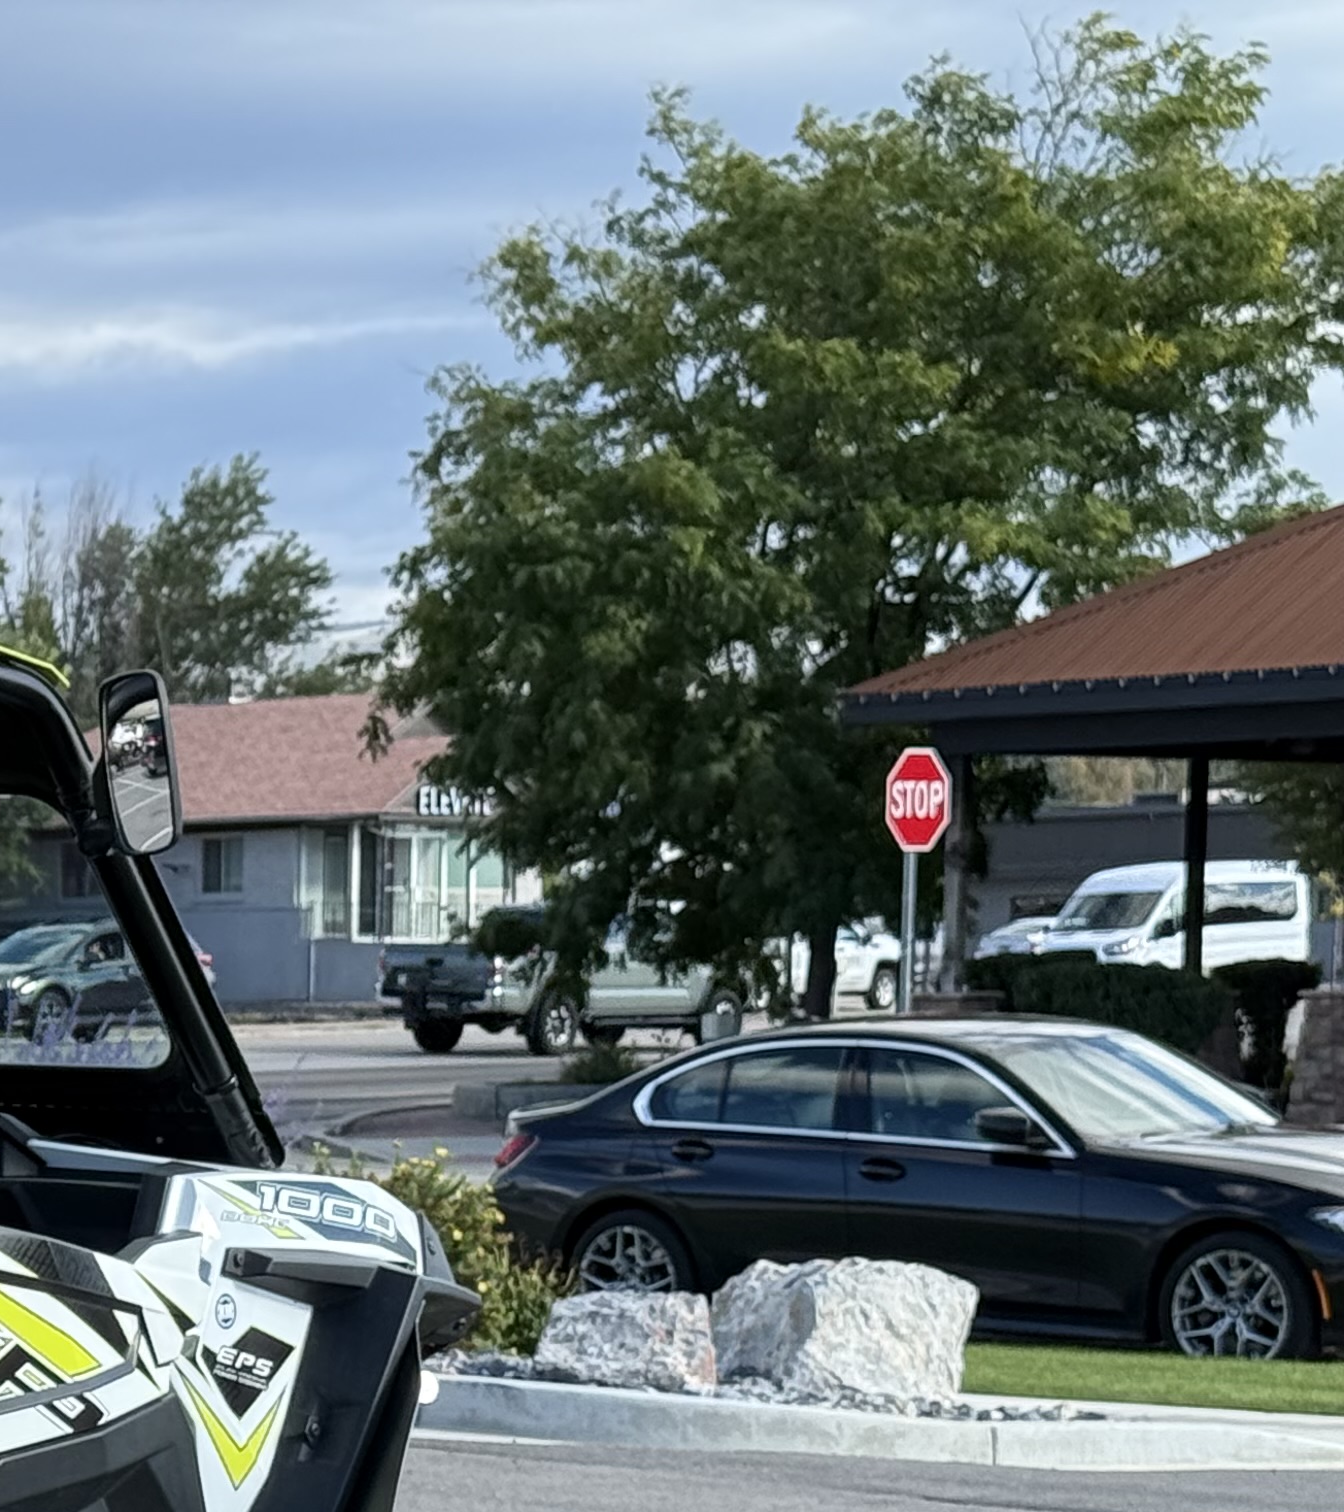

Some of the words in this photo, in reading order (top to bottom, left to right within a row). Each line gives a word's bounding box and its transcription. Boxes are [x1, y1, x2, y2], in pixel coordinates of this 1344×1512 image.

[891, 780, 944, 819] STOP
[257, 1178, 398, 1243] 1000
[216, 1345, 274, 1378] EPS
